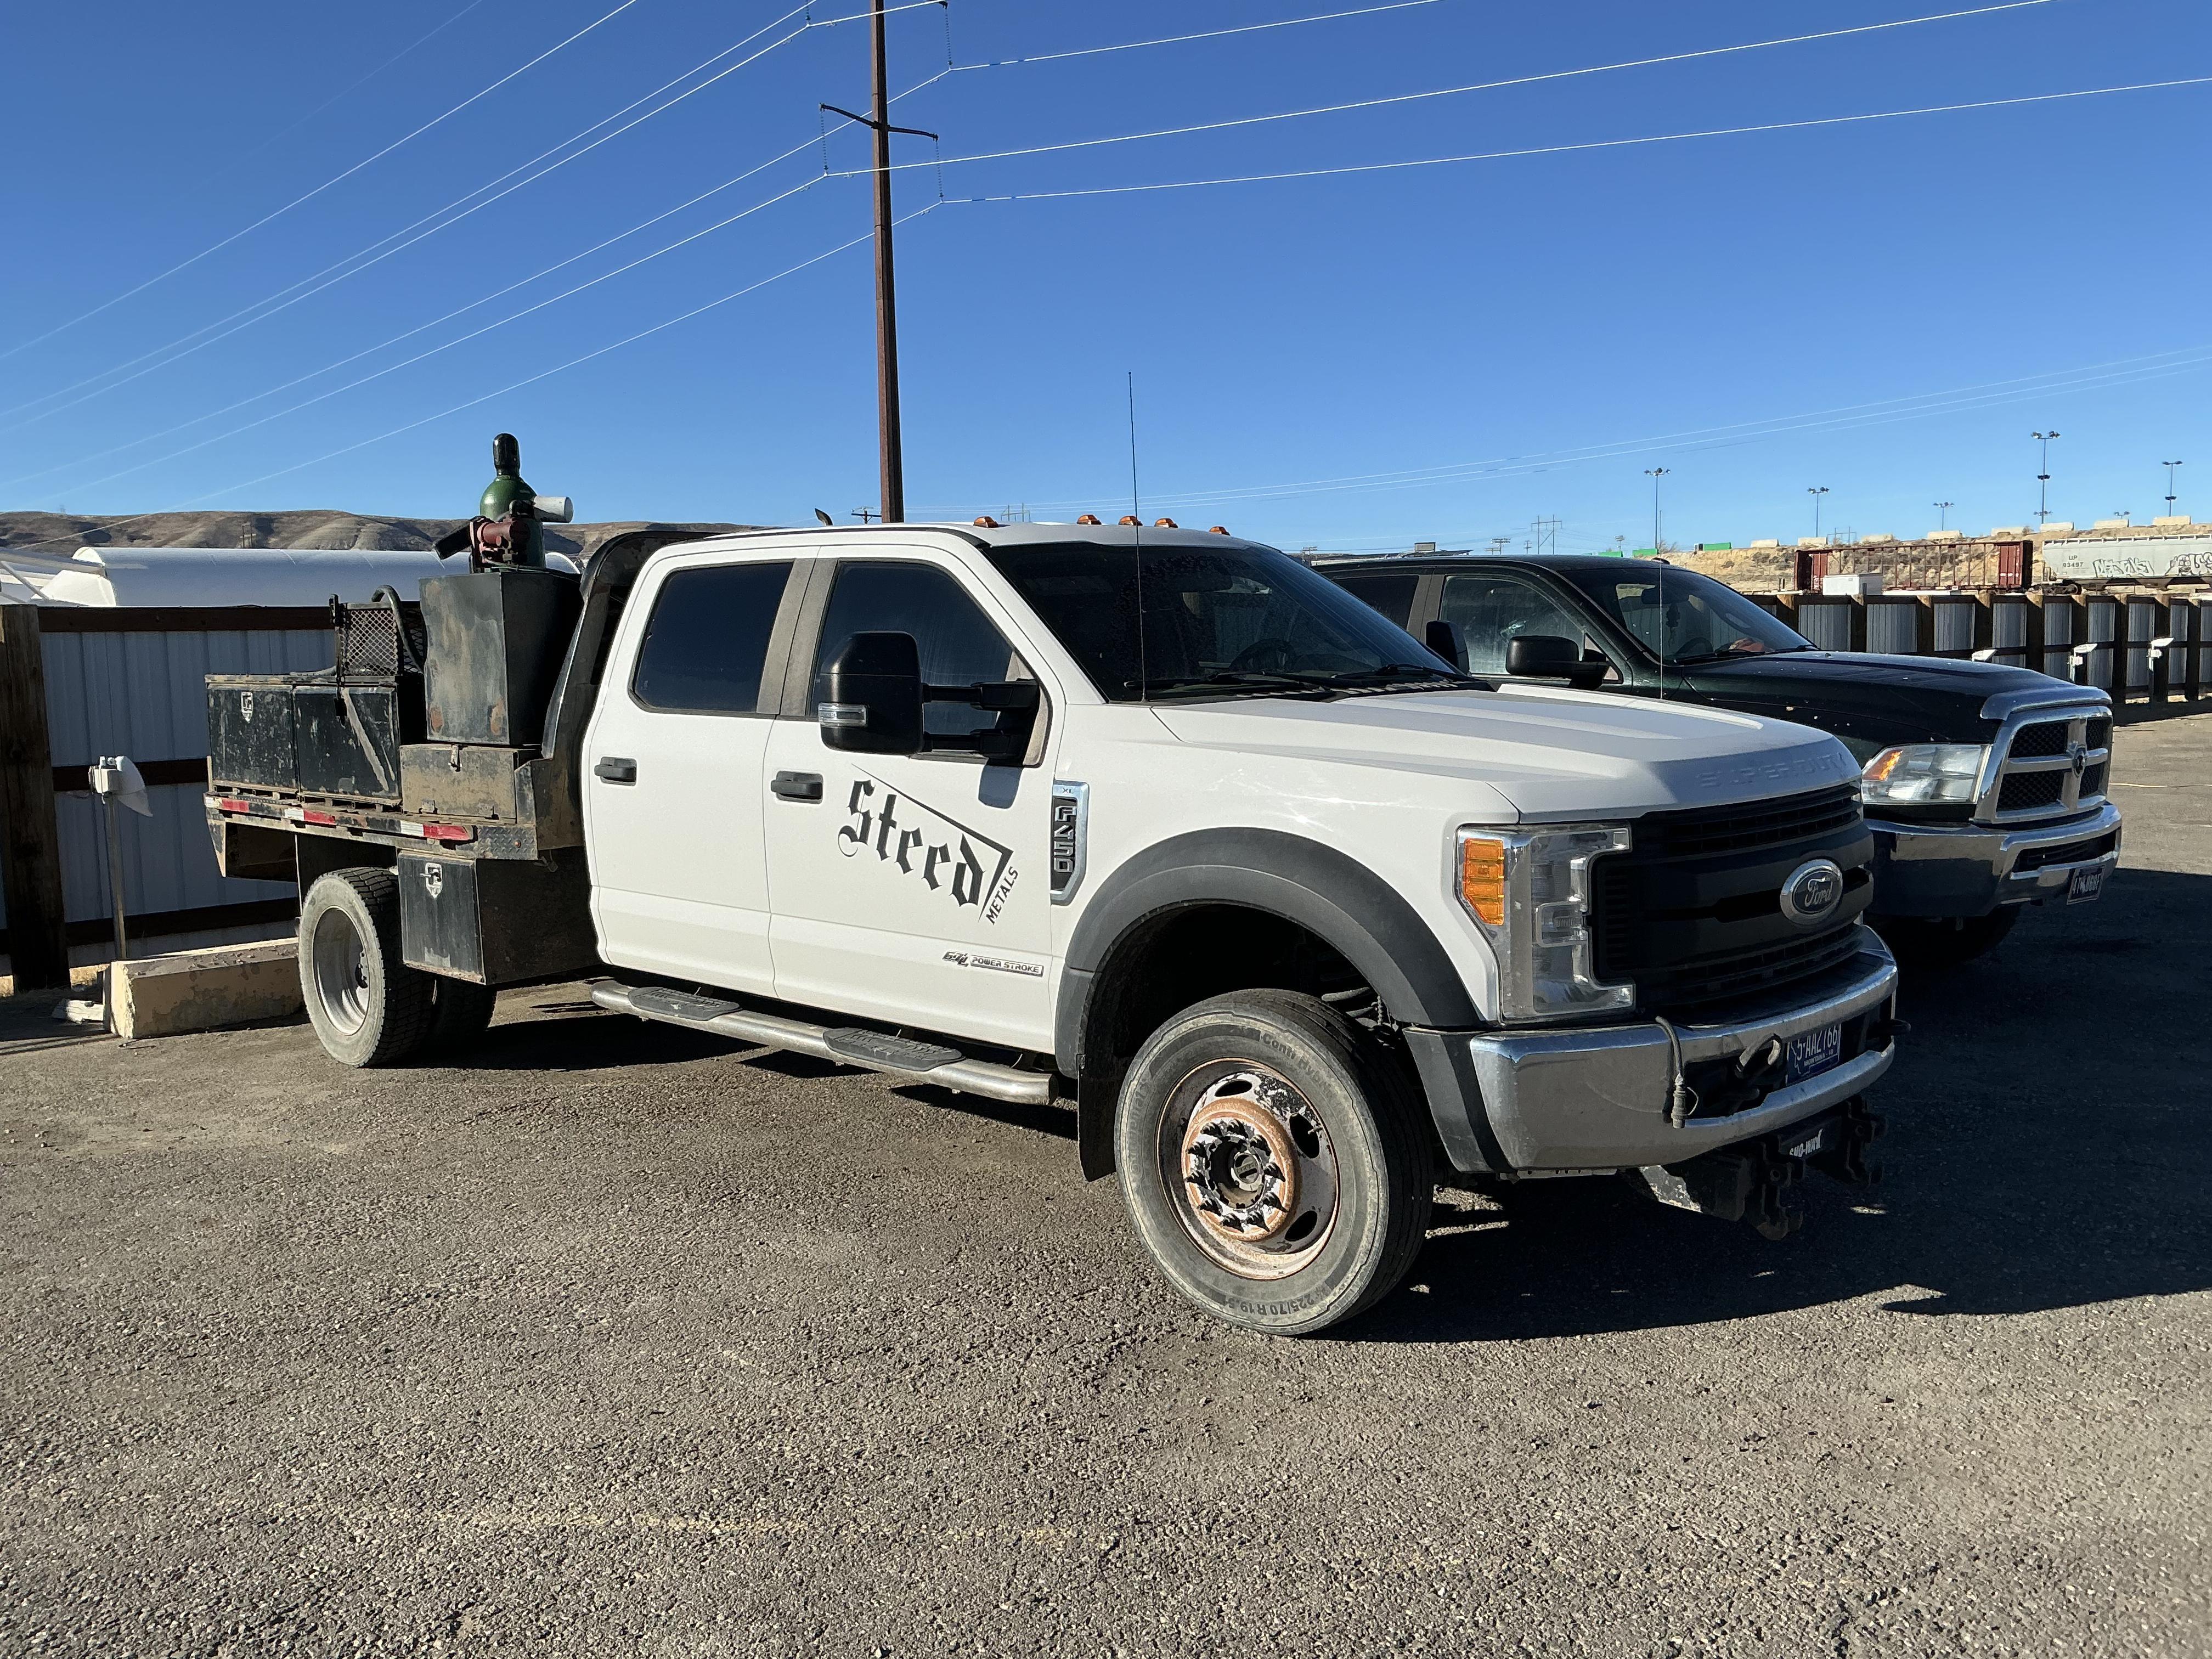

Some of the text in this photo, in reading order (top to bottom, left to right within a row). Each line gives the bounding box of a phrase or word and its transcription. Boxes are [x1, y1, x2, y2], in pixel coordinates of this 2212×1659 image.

[838, 779, 986, 907] Steed
[1054, 805, 1076, 873] F450
[986, 866, 1018, 925] METALS
[1804, 877, 1833, 907] Ford
[972, 956, 1002, 967] POWER
[1003, 962, 1040, 973] STROKE
[1263, 1032, 1296, 1059] Conti
[1269, 1293, 1315, 1316] 225/70
